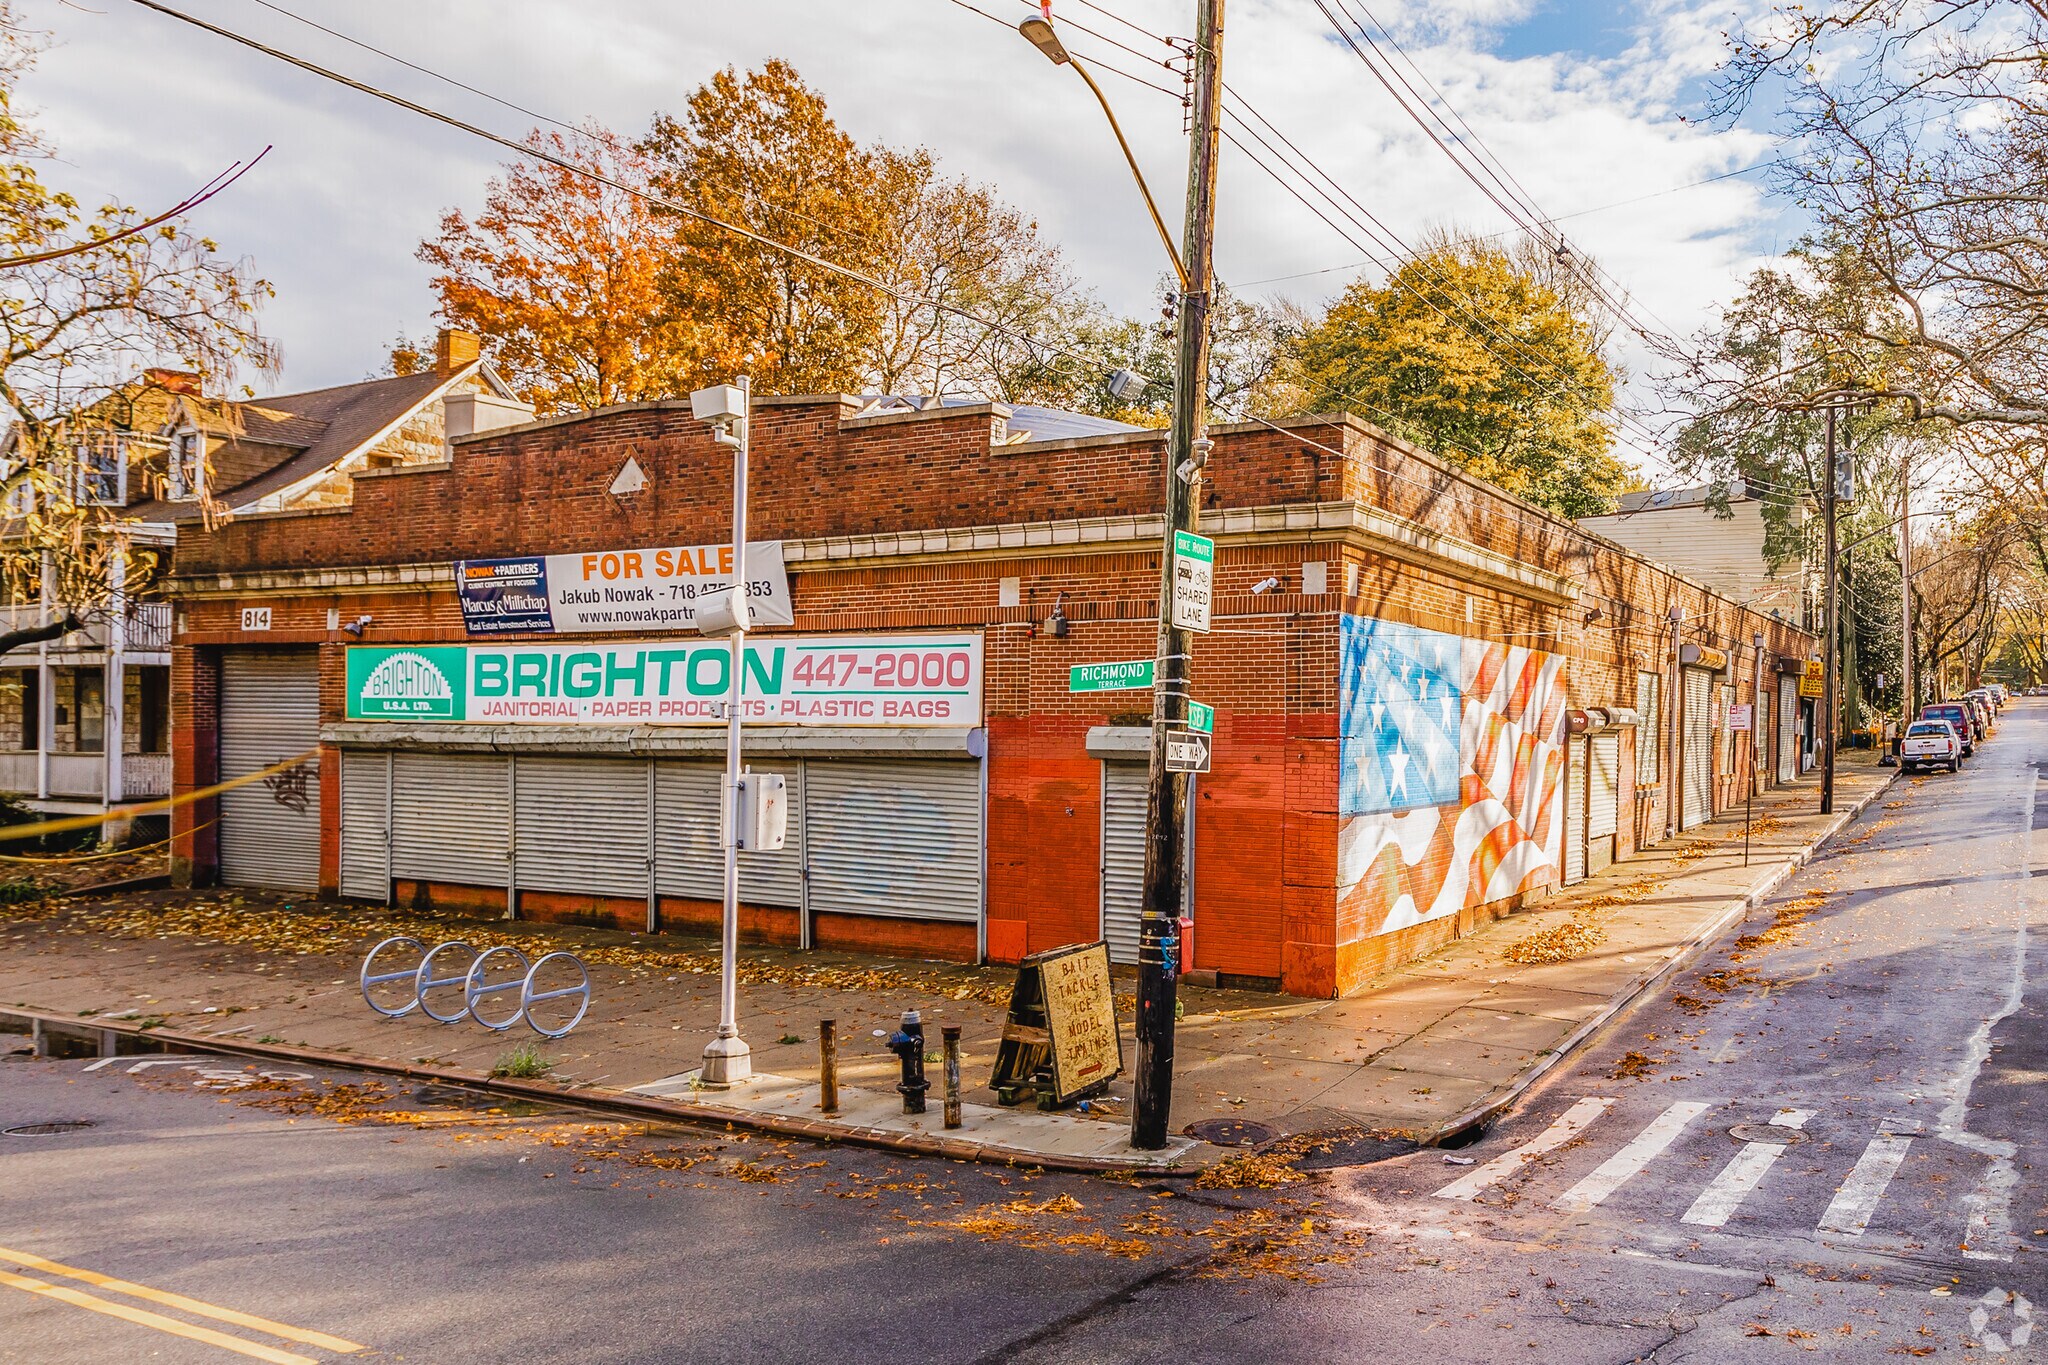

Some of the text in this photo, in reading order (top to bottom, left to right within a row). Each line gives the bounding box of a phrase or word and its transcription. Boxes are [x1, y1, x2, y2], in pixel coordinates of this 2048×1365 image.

[1178, 538, 1210, 557] BIKE ROUTE
[582, 547, 734, 581] FOR SALE
[461, 594, 547, 616] Marcus & Millichap
[559, 588, 600, 605] Jakub
[604, 586, 654, 603] Nowak
[1177, 586, 1208, 606] SHARED
[244, 611, 269, 628] 814
[1181, 605, 1203, 623] LANE
[468, 618, 551, 631] Real Estate Investment Services
[372, 659, 443, 698] BRIGHTON
[474, 647, 971, 698] BRIGHTON 447-2000
[1080, 663, 1145, 682] RICHMOND
[1097, 679, 1127, 689] TERRACE
[383, 701, 433, 711] U.S.A. LTD.
[482, 700, 950, 718] JANITORIAL PAPER PRODTS PLASTIC BAGS
[1170, 744, 1204, 760] ONE WAY
[1061, 956, 1091, 976] BAIT
[1058, 973, 1100, 998] TACKLE
[1073, 998, 1093, 1015] ICE
[1067, 1018, 1103, 1038] MODEL
